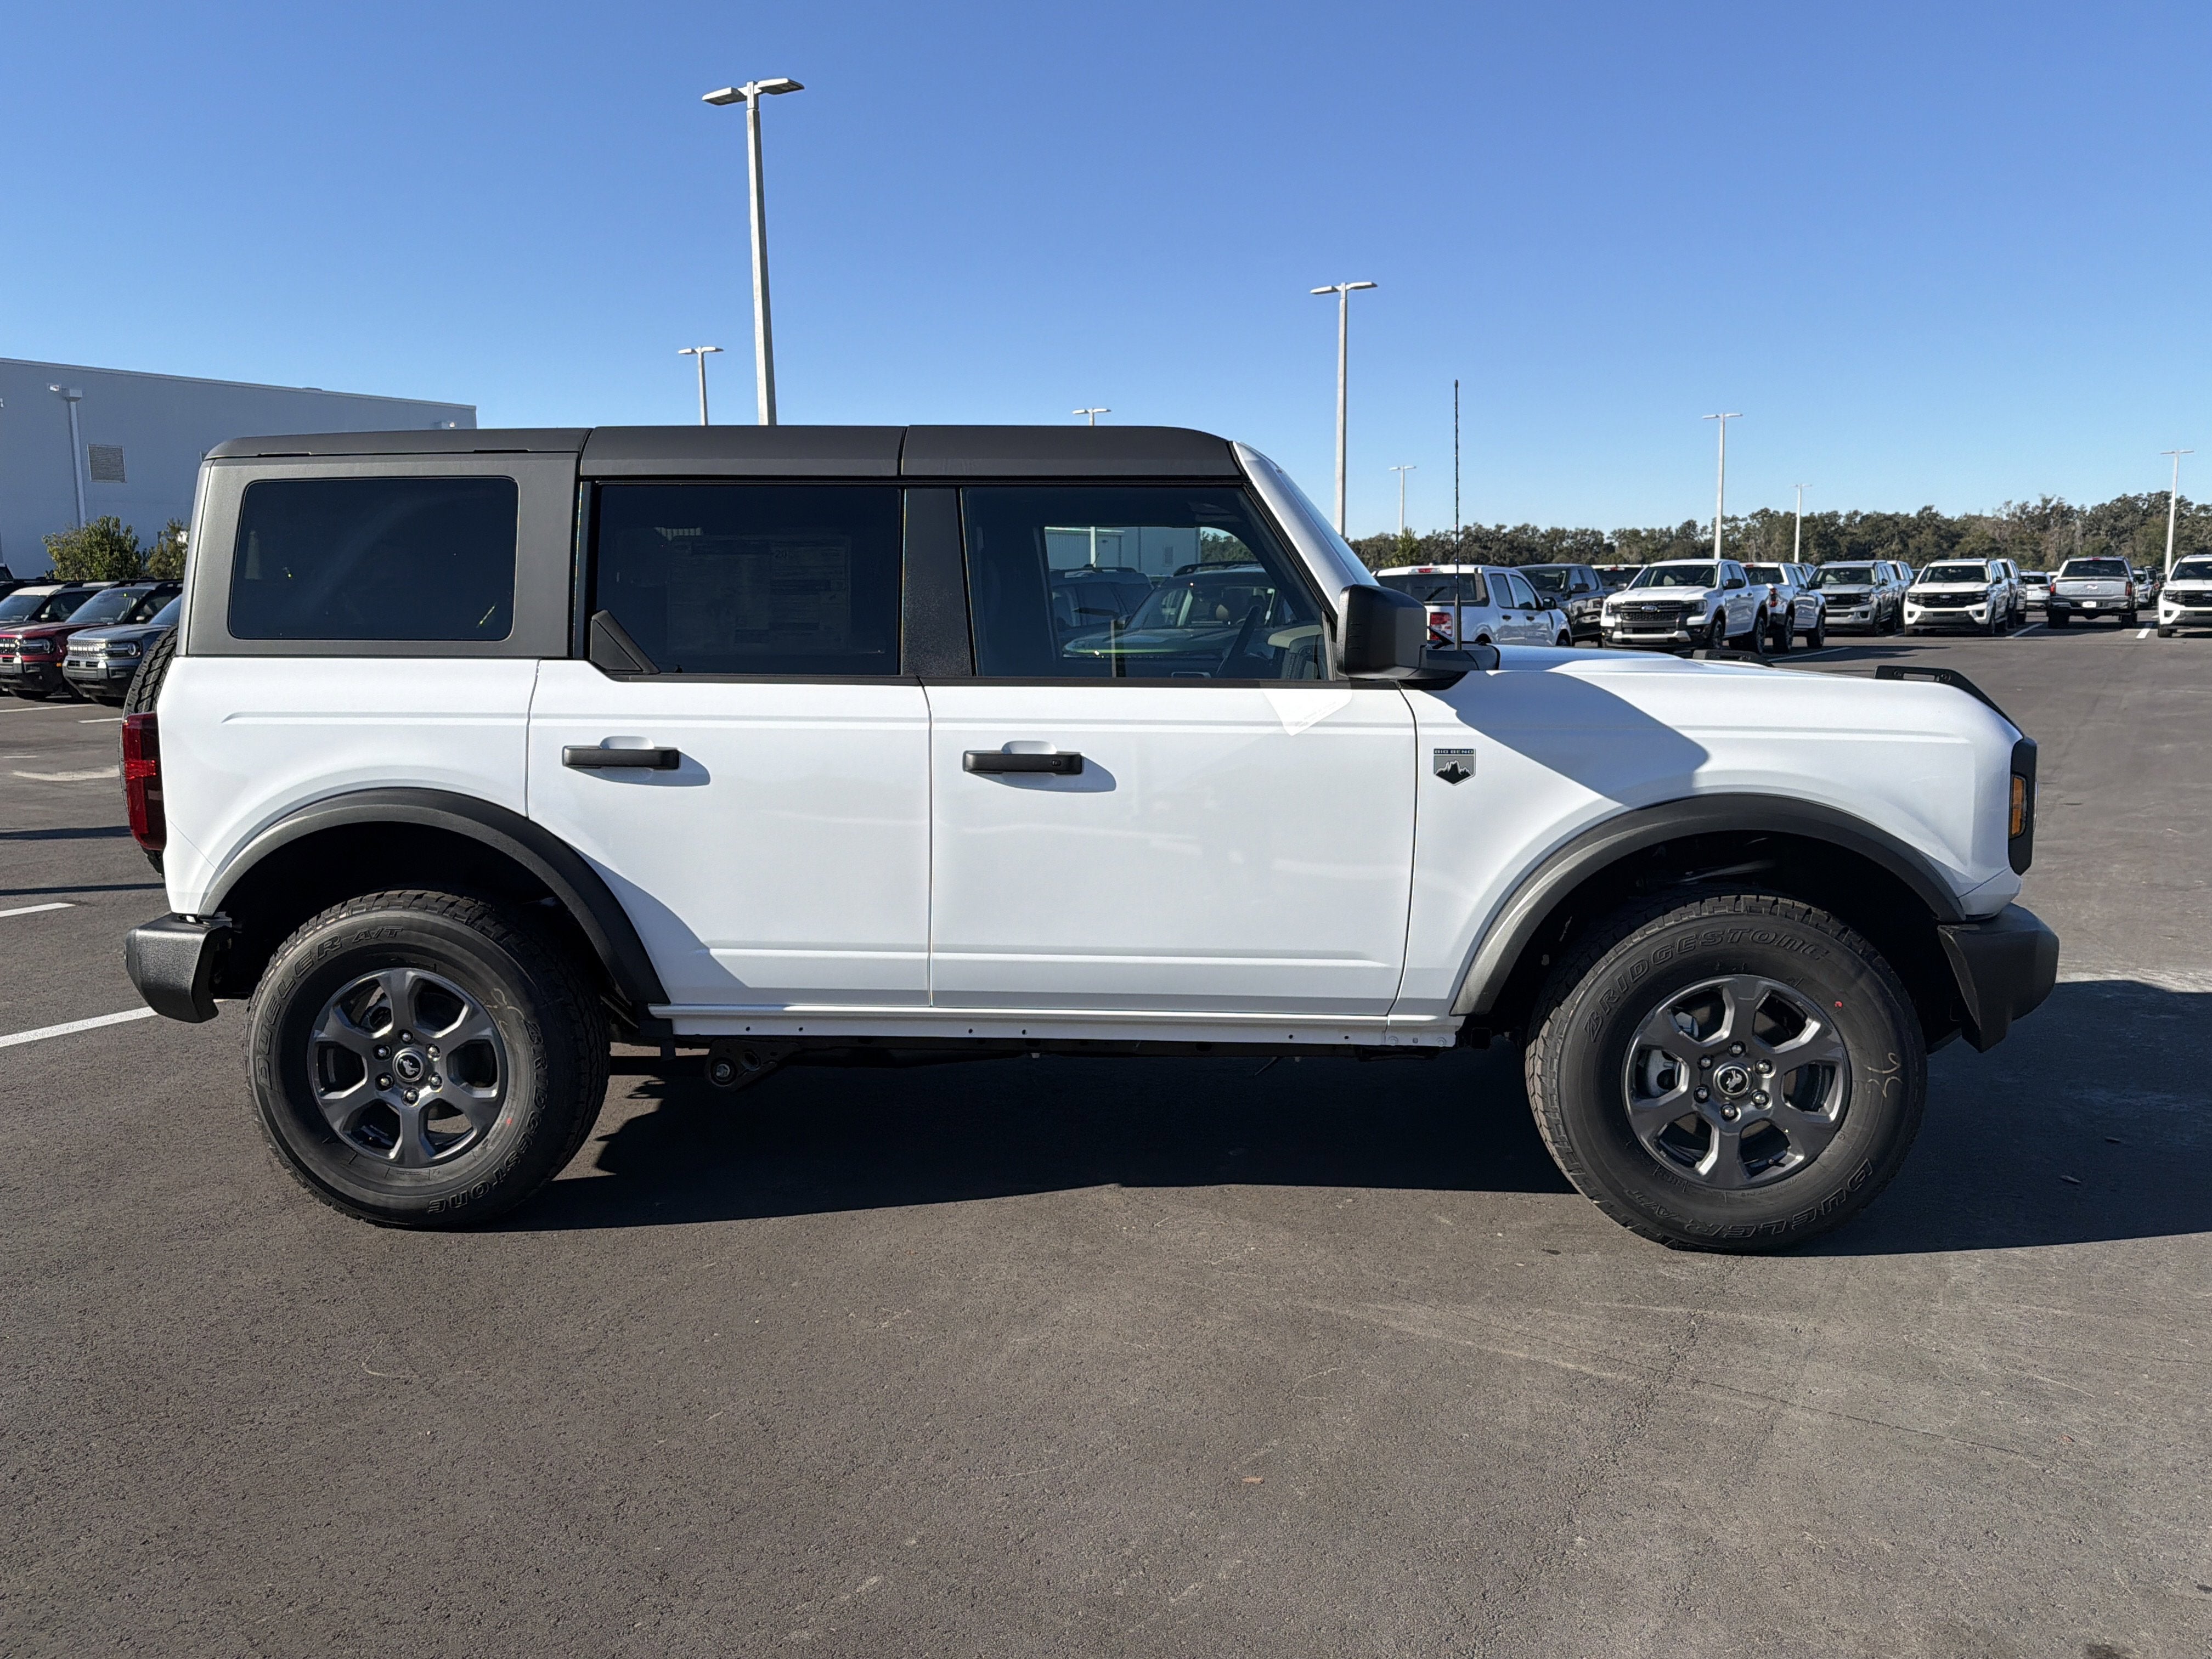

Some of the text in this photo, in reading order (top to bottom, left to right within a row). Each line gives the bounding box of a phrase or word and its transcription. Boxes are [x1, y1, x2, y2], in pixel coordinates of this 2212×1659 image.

[256, 926, 403, 1090] DUELER A/T
[1582, 928, 1831, 1043] BRIDGESTONE
[427, 1019, 549, 1214] BRIDGESTONE
[1685, 1157, 1874, 1239] DUELER
